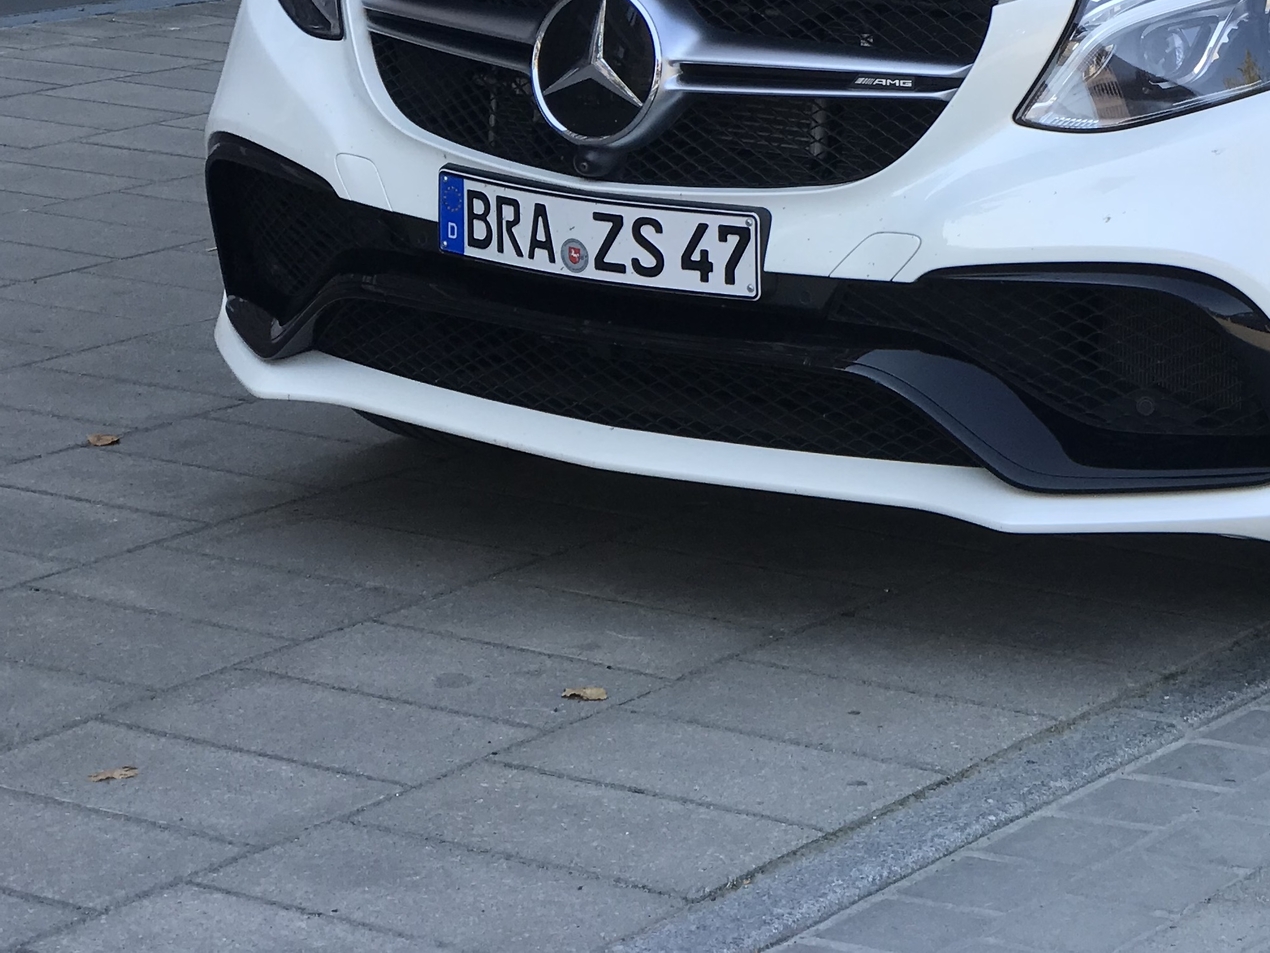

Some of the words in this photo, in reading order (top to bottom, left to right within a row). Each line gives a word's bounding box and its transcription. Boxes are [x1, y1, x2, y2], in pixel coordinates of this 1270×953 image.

[872, 78, 913, 87] AMG
[448, 222, 458, 239] D
[466, 188, 556, 265] BRA
[592, 211, 666, 278] ZS
[681, 222, 752, 286] 47
